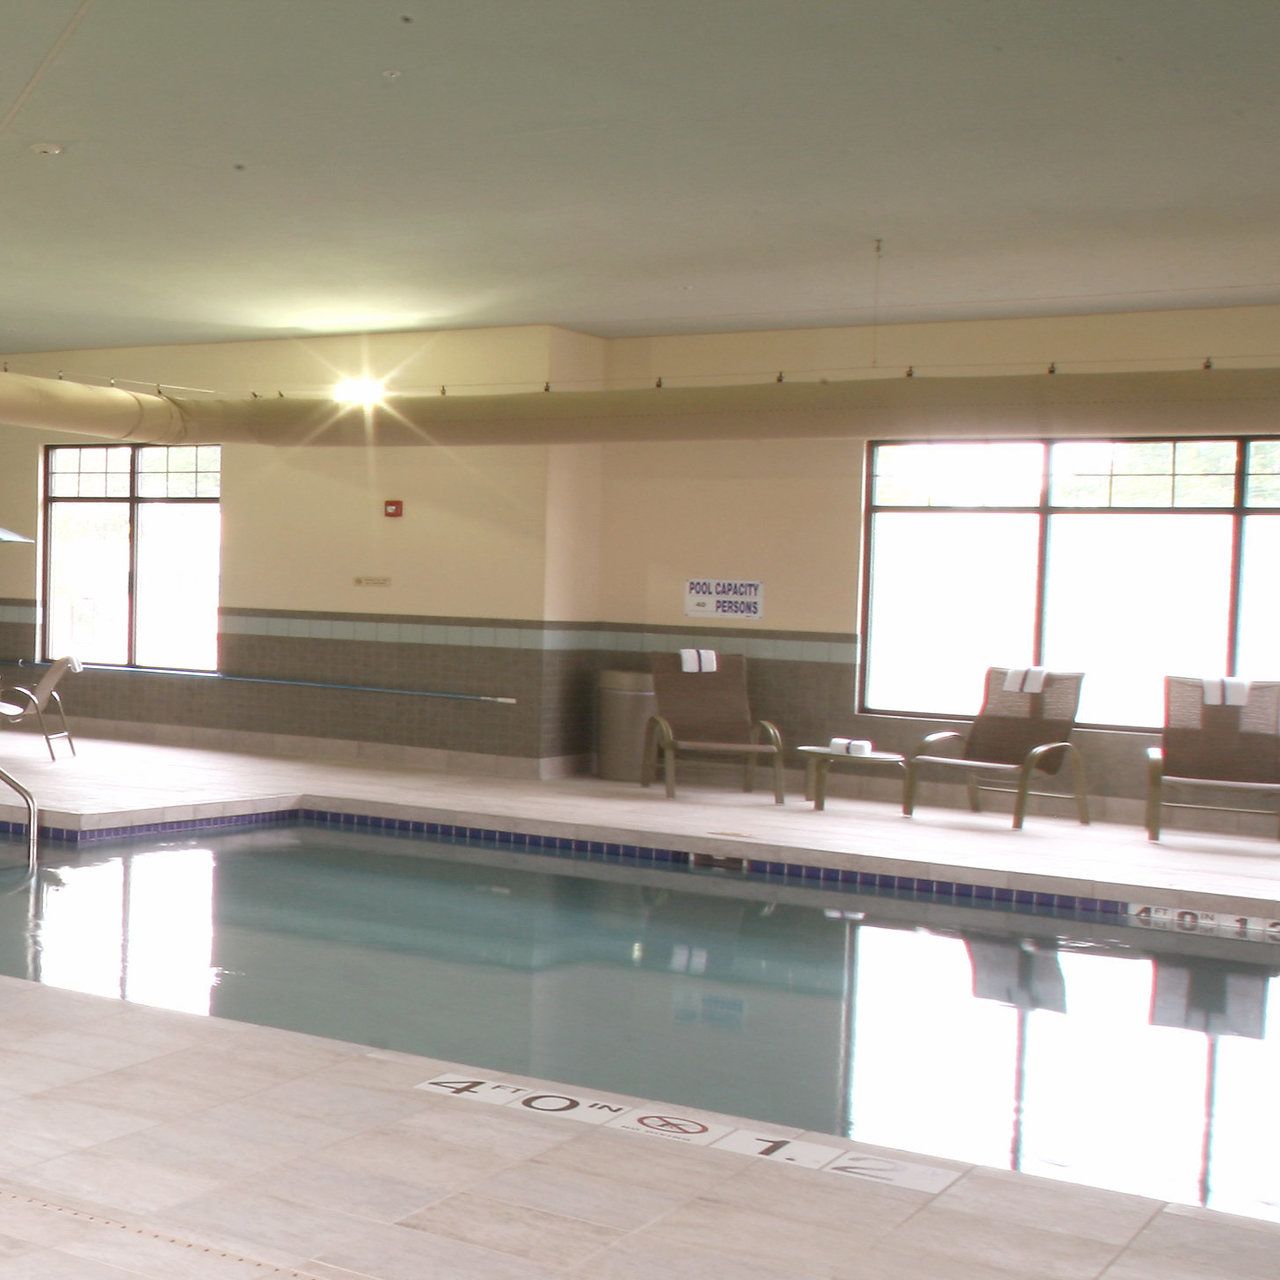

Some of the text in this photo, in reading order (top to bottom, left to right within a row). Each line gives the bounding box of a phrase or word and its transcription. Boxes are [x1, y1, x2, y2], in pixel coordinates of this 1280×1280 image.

[689, 581, 759, 597] POOL CAPACITY
[715, 600, 758, 614] PERSONS
[428, 1080, 487, 1095] 4
[491, 1084, 528, 1094] FT
[521, 1095, 580, 1112] 0
[587, 1102, 624, 1113] IN
